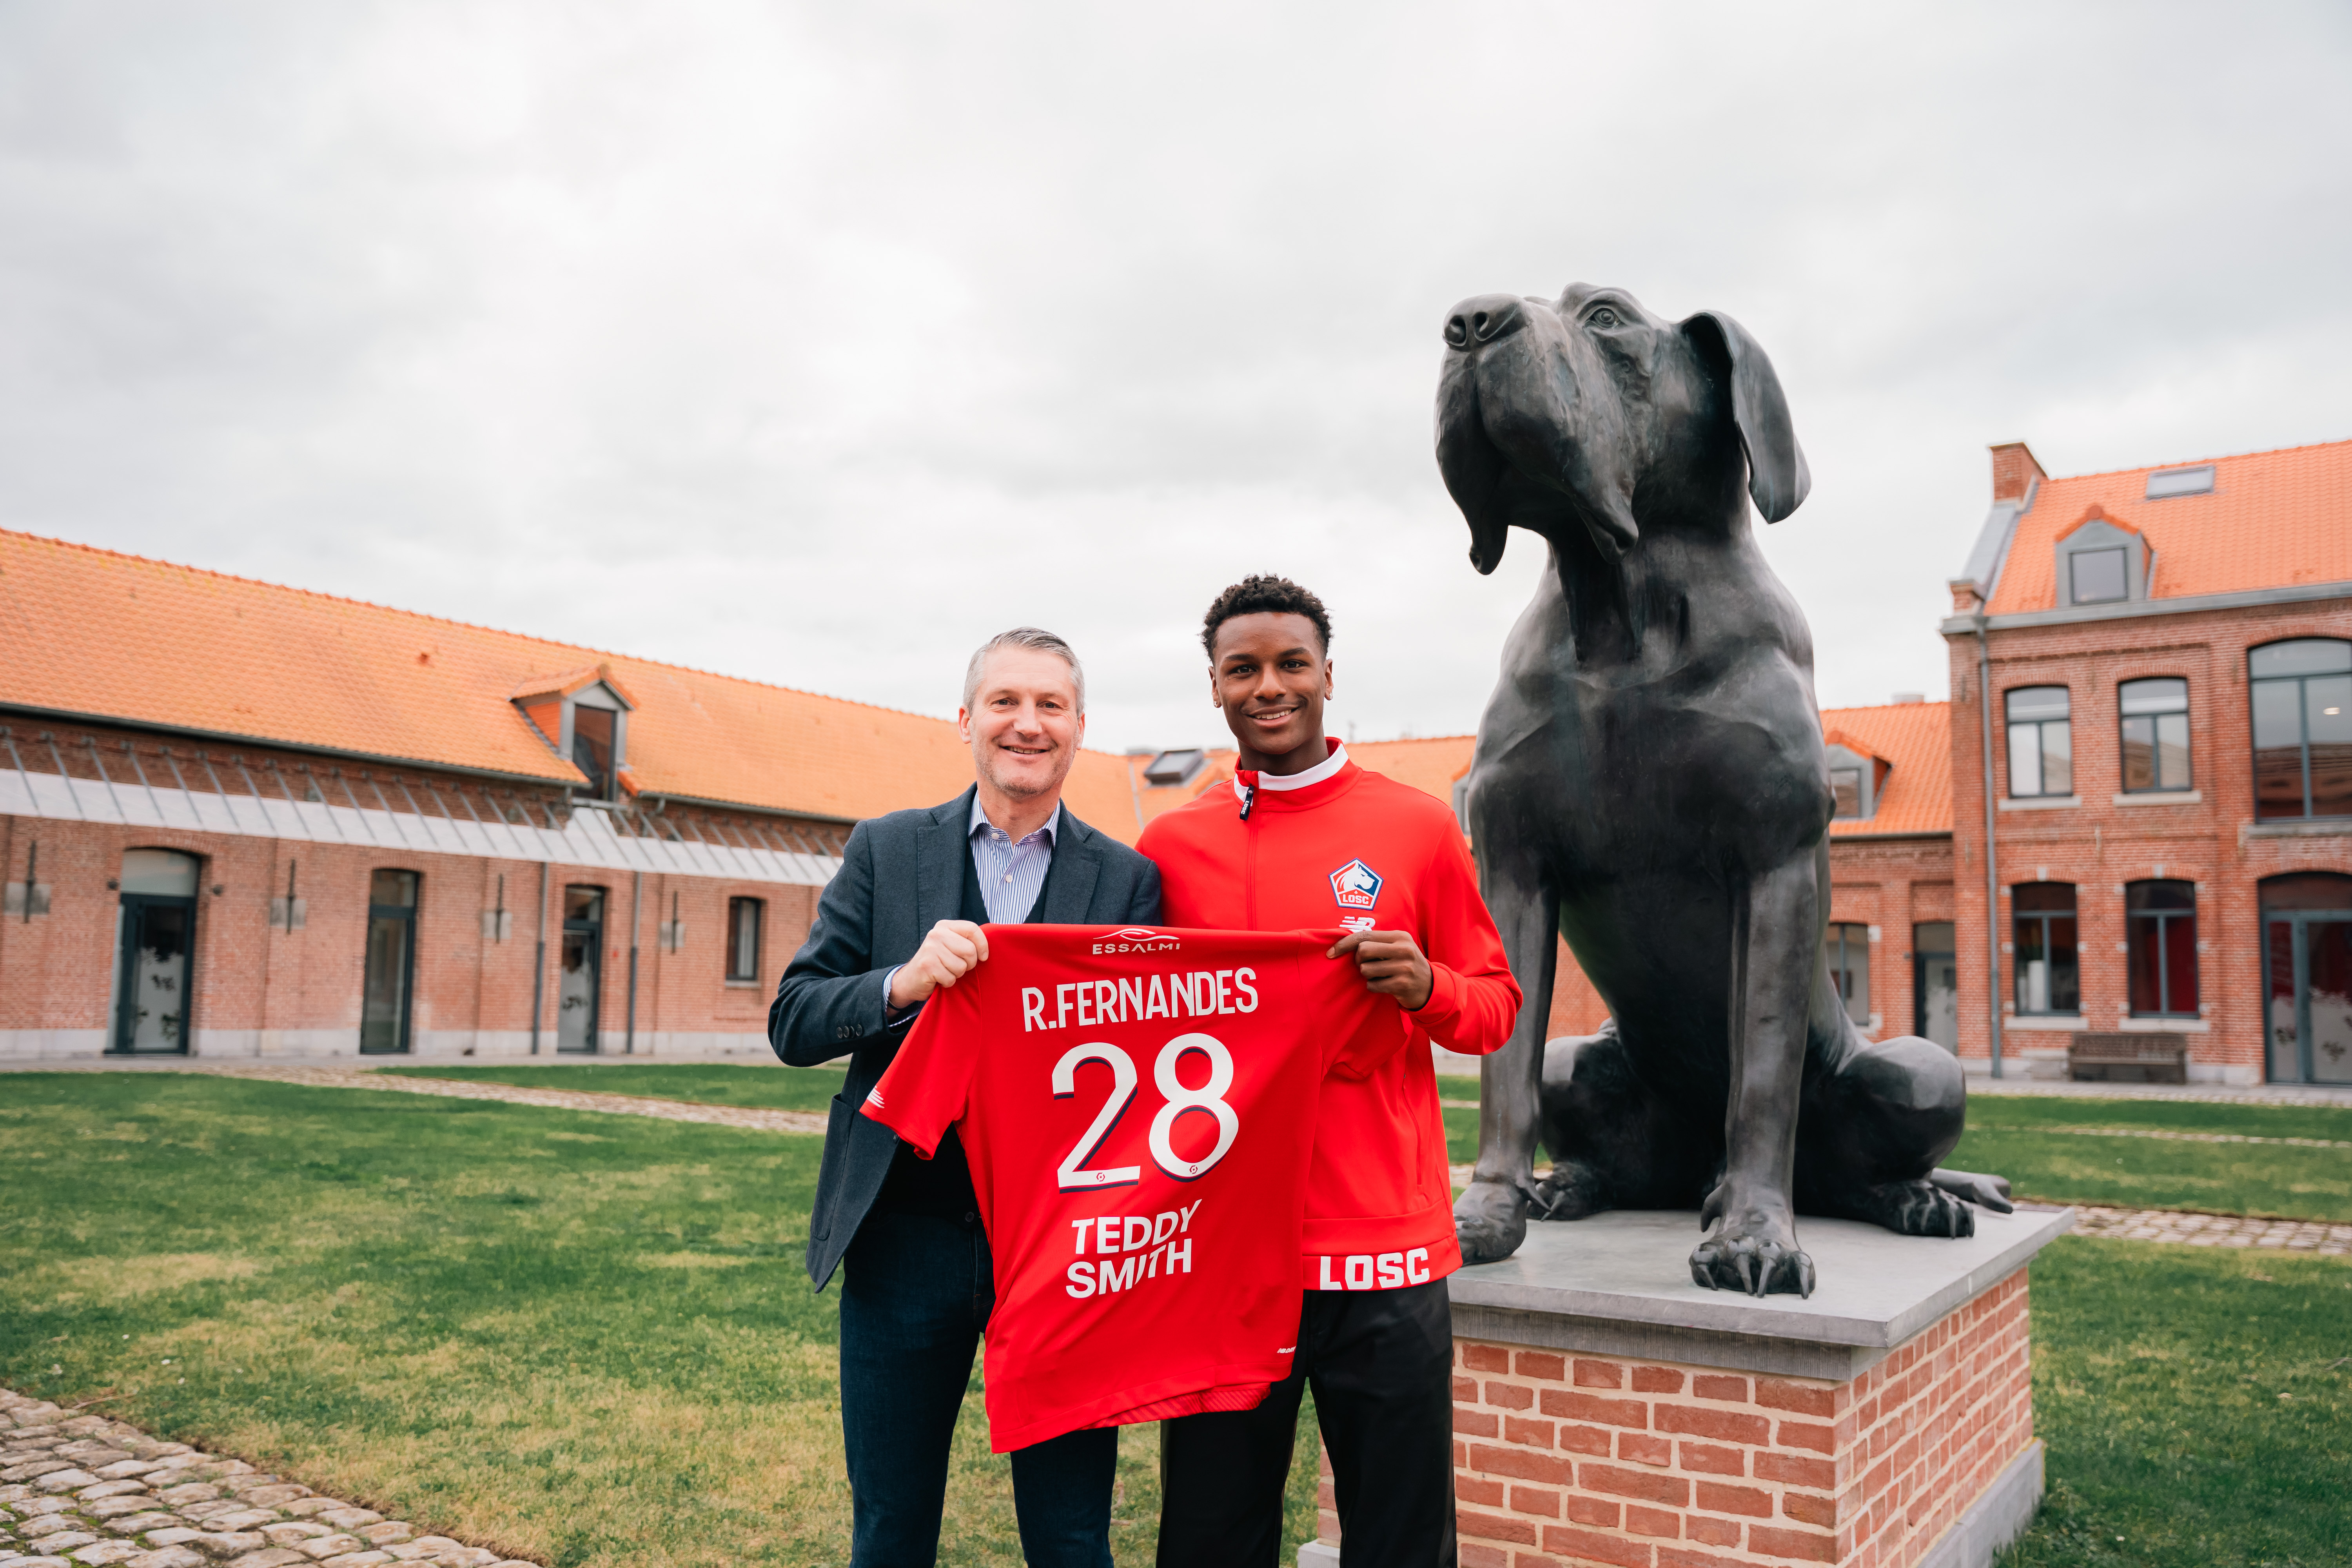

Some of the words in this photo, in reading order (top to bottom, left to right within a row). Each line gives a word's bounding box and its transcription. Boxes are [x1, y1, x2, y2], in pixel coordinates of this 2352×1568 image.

[1241, 800, 1250, 815] LOSC
[1343, 894, 1369, 904] LOSC
[1093, 943, 1180, 955] ESSALMI
[1022, 967, 1258, 1032] R.FERNANDES
[1052, 1033, 1239, 1194] 28
[1071, 1198, 1203, 1254] TEDDY
[1065, 1238, 1192, 1298] SMITH
[1320, 1247, 1430, 1290] LOSC
